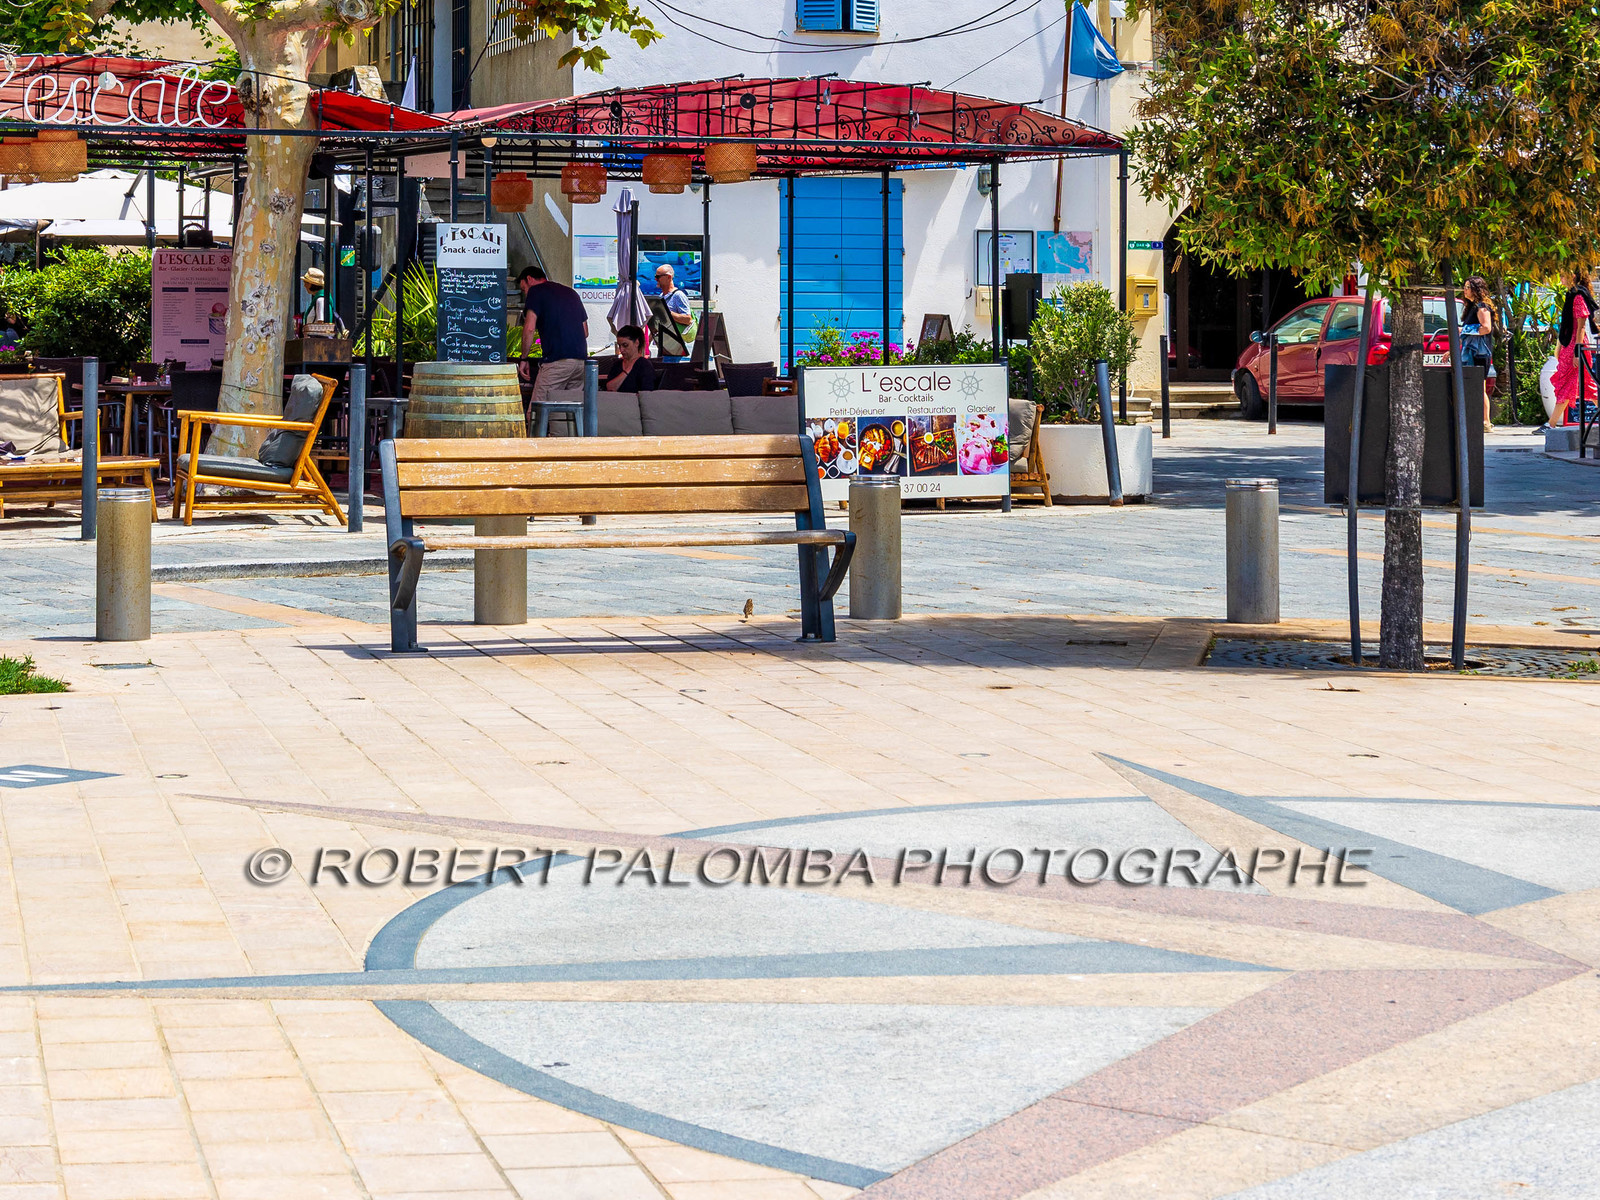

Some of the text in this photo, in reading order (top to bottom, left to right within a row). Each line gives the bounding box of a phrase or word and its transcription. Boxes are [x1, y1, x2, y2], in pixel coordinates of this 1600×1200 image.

[443, 246, 500, 254] Snack Glacier
[158, 254, 216, 265] L'ESCALE
[581, 291, 616, 300] DOUCHES
[861, 371, 951, 393] L'escale
[878, 393, 934, 403] Bar Cocktails
[829, 404, 996, 416] Petit-Déjeuner Restauration Glacier
[903, 483, 941, 493] 37 00 24
